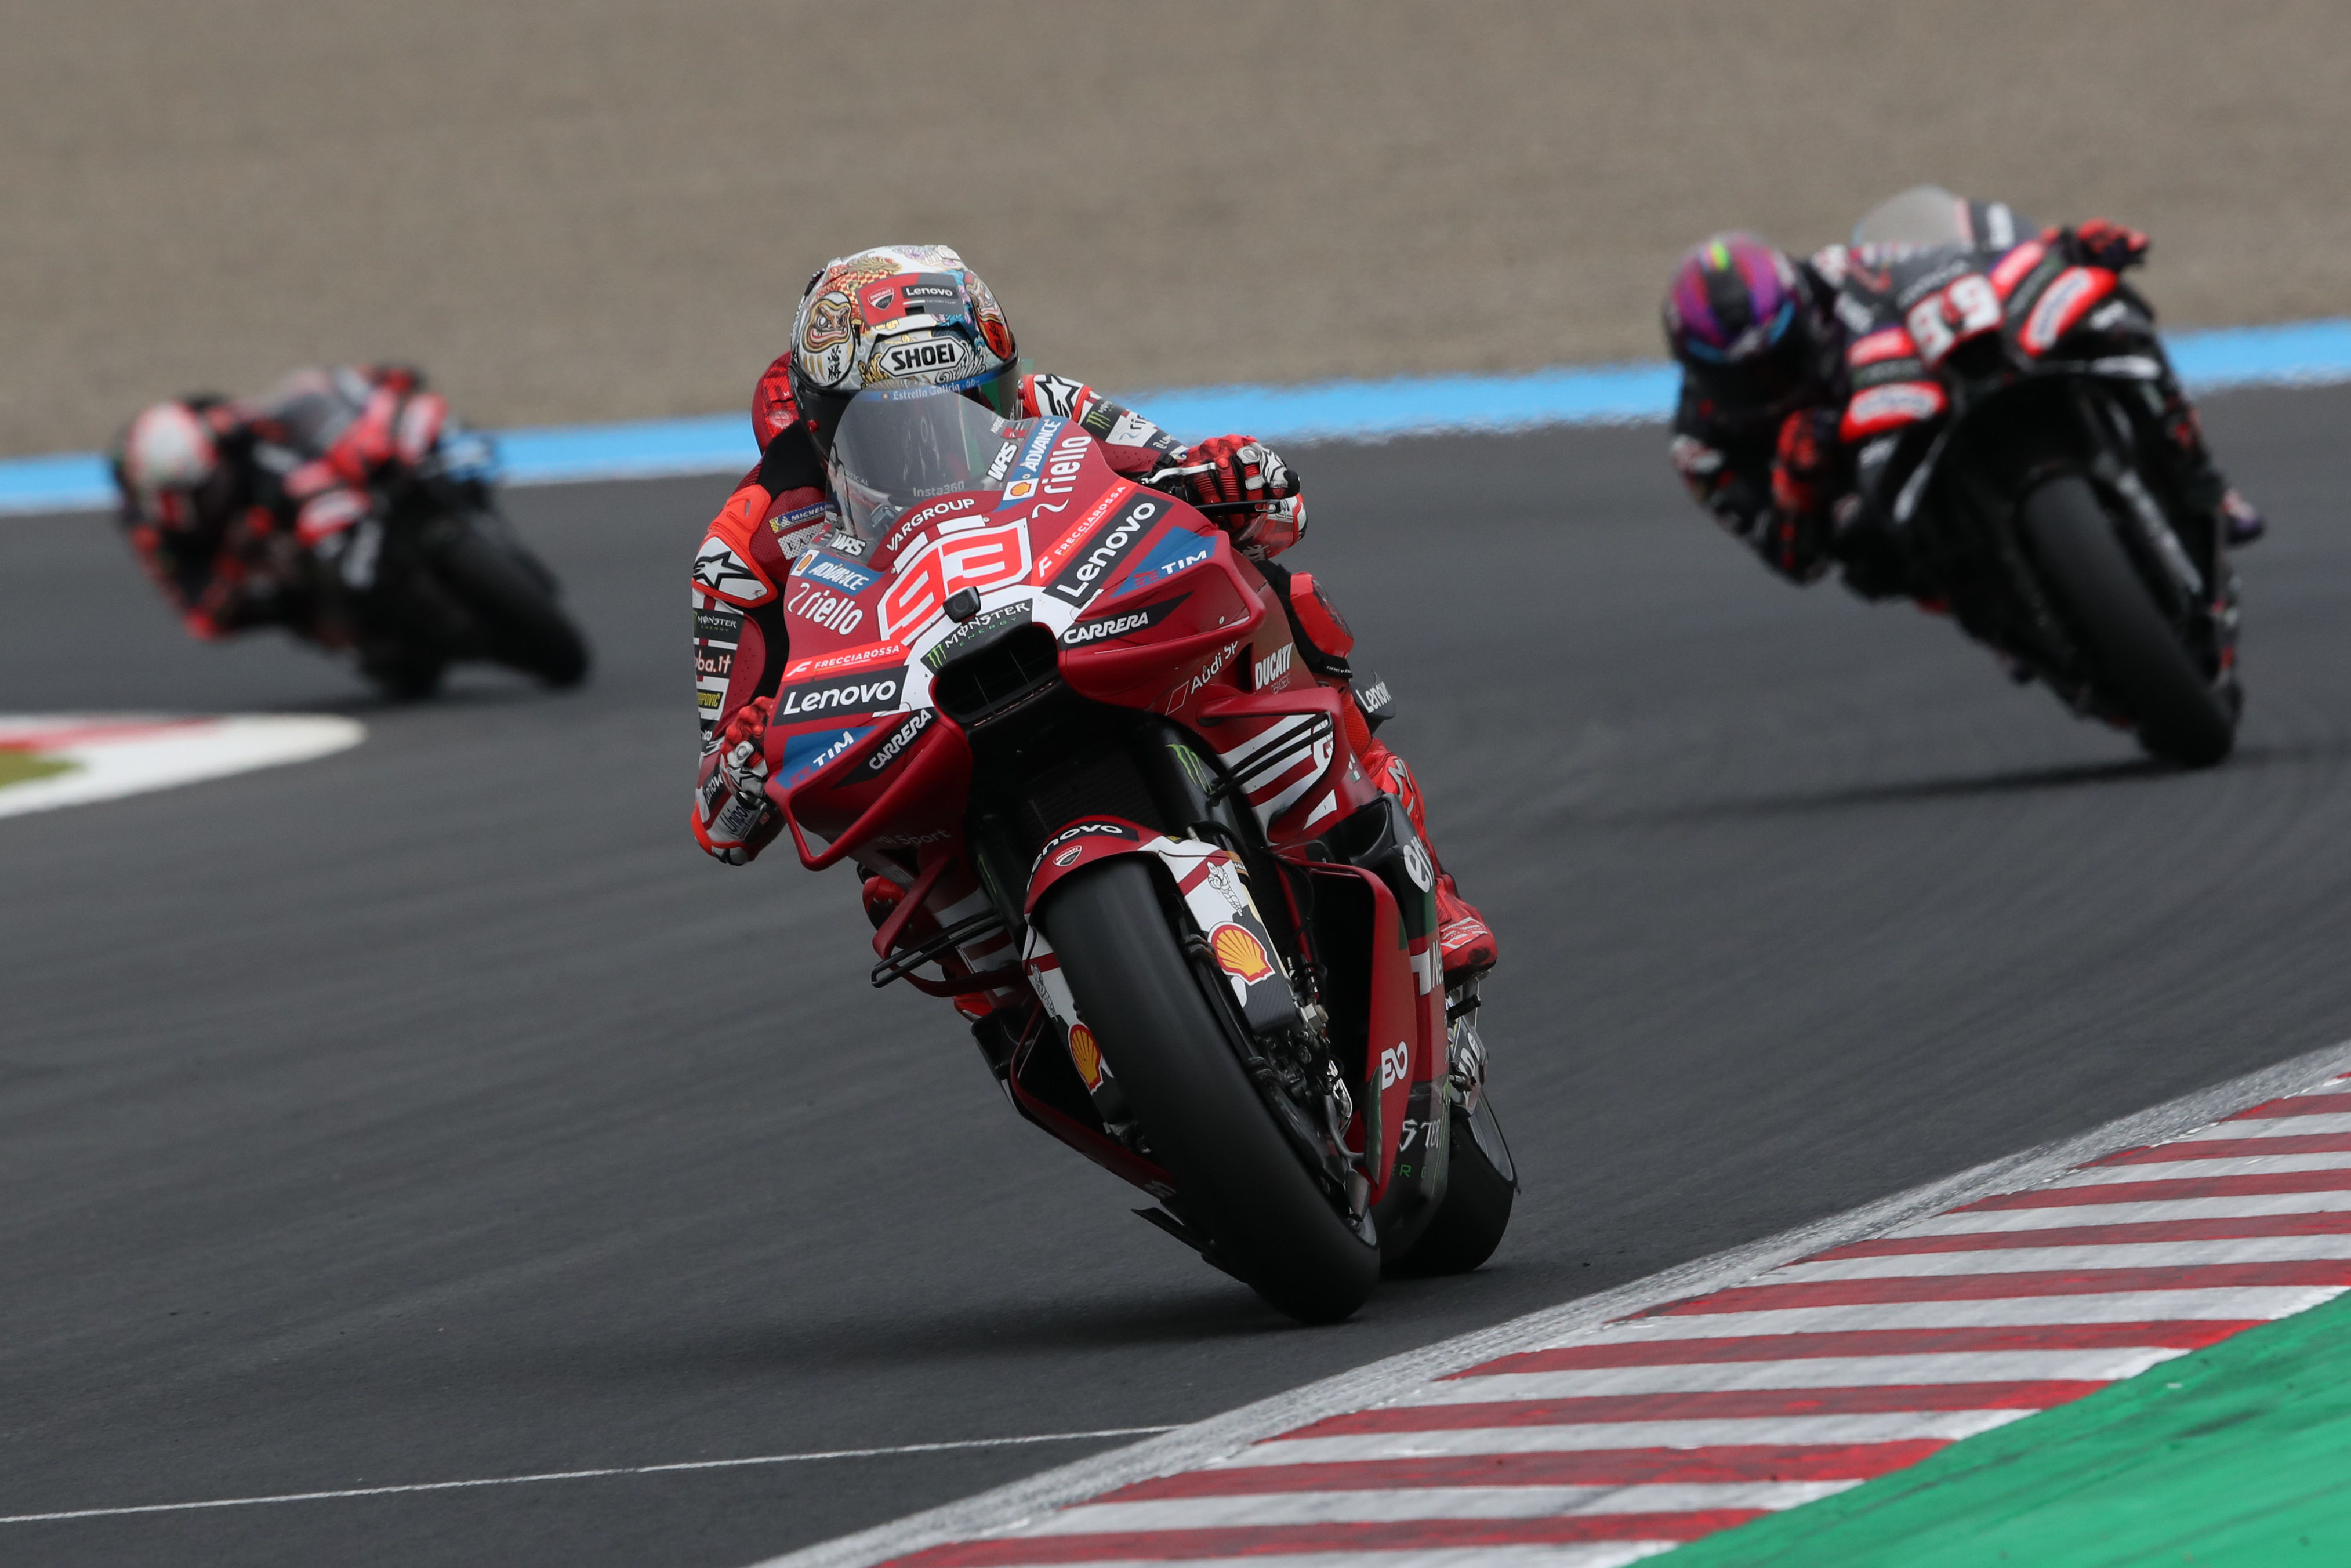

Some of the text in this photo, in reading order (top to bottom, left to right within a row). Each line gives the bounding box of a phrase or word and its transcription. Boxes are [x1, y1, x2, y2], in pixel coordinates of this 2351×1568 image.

[870, 288, 891, 300] DUCATI
[906, 287, 953, 297] Lenovo
[891, 343, 956, 371] SHOEI
[892, 388, 927, 400] Estrella
[929, 382, 960, 395] Galicia
[987, 442, 1018, 481] WRS
[1024, 420, 1062, 473] ADVANCE
[1042, 436, 1092, 494] riello
[913, 481, 965, 499] Insta360
[791, 504, 825, 522] MICHEL
[886, 498, 975, 551] VARGROUP
[1054, 485, 1126, 556] FRECCIAROSSA
[830, 533, 866, 556] WRS
[1057, 502, 1156, 599] Lenovo
[808, 560, 870, 592] ADVANCE
[1161, 550, 1207, 575] TIM
[883, 525, 1025, 644] 93
[697, 615, 737, 629] MONSTER
[797, 590, 865, 636] riello
[945, 602, 1031, 648] MONSTER
[1063, 612, 1149, 644] CARRERA
[959, 616, 1017, 647] ENERGY
[814, 645, 900, 669] FRECCIAROSSA
[1191, 652, 1222, 695] Audi
[1254, 642, 1294, 691] DUCATI
[783, 680, 897, 716] Lenovo
[812, 730, 855, 767] TIM
[869, 708, 933, 770] CARRERA
[1055, 847, 1079, 862] DUCATI
